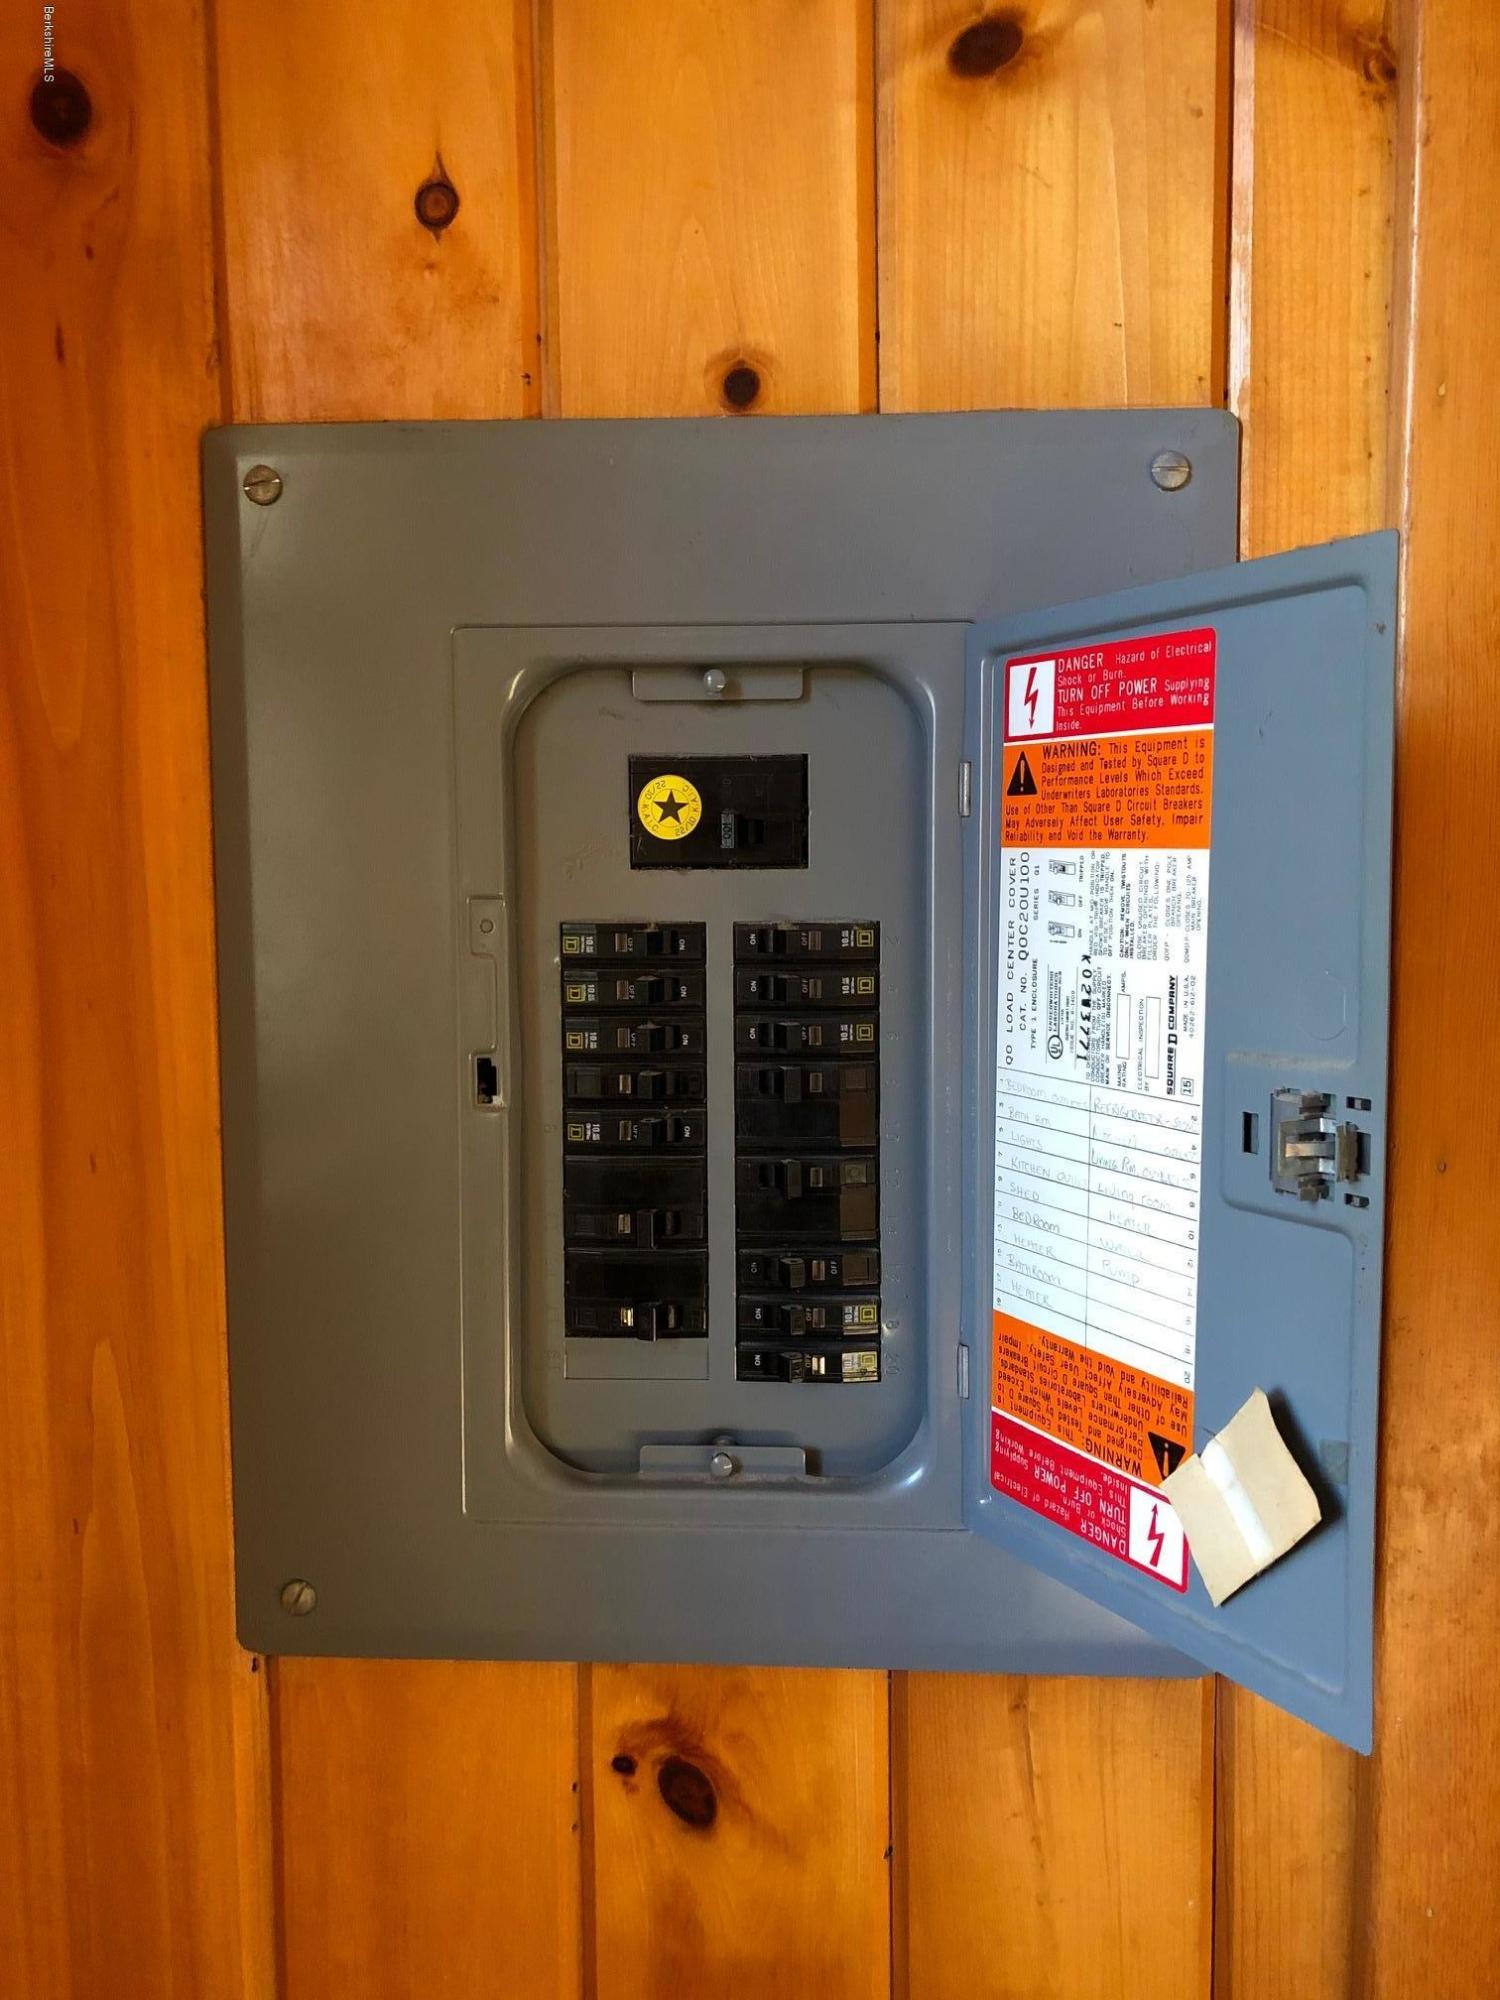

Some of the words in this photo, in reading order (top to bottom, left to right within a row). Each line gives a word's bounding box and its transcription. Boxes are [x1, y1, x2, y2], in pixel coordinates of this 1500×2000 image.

[1057, 652, 1103, 673] DANGER
[1115, 650, 1144, 664] Hazard
[1150, 648, 1159, 659] of
[1165, 639, 1211, 658] Electrical
[1057, 673, 1081, 687] Shock
[1087, 674, 1096, 682] or
[1102, 667, 1126, 680] Burn.
[1057, 687, 1083, 703] TURN
[1091, 683, 1110, 699] OFF
[1119, 677, 1157, 695] POWER
[1164, 675, 1209, 693] Supplying
[1057, 705, 1073, 717] This
[1079, 699, 1125, 716] Equipment
[1132, 696, 1163, 709] Before
[1170, 691, 1209, 708] Working
[1056, 719, 1081, 730] Inside.
[1042, 741, 1100, 759] WARNING:
[1108, 742, 1127, 753] This
[1135, 737, 1187, 754] Equipment
[1195, 736, 1204, 746] is
[1041, 761, 1075, 775] Designed
[1080, 760, 1093, 769] and
[1099, 756, 1126, 769] Tested
[1132, 755, 1141, 769] by
[1147, 753, 1176, 767] Square
[1182, 752, 1188, 763] D
[1195, 752, 1204, 762] to
[1041, 774, 1093, 787] Performance
[1100, 772, 1127, 783] Levels
[1135, 769, 1161, 781] Which
[1168, 767, 1203, 779] Exceed
[1041, 788, 1090, 800] Underwriters
[1096, 785, 1148, 797] Laboratories
[1155, 783, 1203, 794] Standards.
[1006, 805, 1018, 815] Use
[1023, 805, 1031, 814] of
[1036, 804, 1055, 813] Other
[1061, 803, 1077, 812] Than
[1083, 801, 1109, 814] Square
[1116, 800, 1121, 811] D
[1127, 799, 1156, 810] Circuit
[1163, 797, 1202, 809] Breakers
[1005, 818, 1019, 829] May
[1025, 817, 1063, 829] Adversely
[1070, 816, 1097, 826] Affect
[1103, 814, 1123, 825] User
[1172, 813, 1202, 825] Impair
[1005, 830, 1043, 842] Reliability
[1048, 830, 1061, 840] and
[1067, 830, 1083, 840] Void
[1089, 829, 1102, 839] the
[1008, 857, 1016, 907] COVER
[750, 933, 756, 945] ON
[1006, 919, 1014, 980] CENTER
[751, 980, 757, 992] ON
[1167, 974, 1176, 1030] COMPANY
[750, 1027, 756, 1039] ON
[1168, 1032, 1177, 1045] D
[1005, 1043, 1013, 1065] QO
[1166, 1046, 1174, 1095] SQUARE
[1182, 1079, 1192, 1094] 15
[998, 1331, 1020, 1350] Impair
[998, 1344, 1027, 1366] Breakers
[1079, 1353, 1091, 1367] the
[1033, 1360, 1057, 1379] Circuit
[1060, 1359, 1078, 1375] User
[1097, 1361, 1114, 1376] Void
[997, 1382, 1004, 1393] to
[998, 1370, 1024, 1390] Exceed
[1062, 1373, 1067, 1384] D
[1072, 1375, 1097, 1398] Square
[1084, 1369, 1111, 1389] Affect
[1120, 1370, 1134, 1385] and
[1008, 1387, 1013, 1397] D
[1029, 1384, 1051, 1402] Which
[1039, 1375, 1085, 1405] Laboratories
[1104, 1391, 1120, 1407] Than
[1118, 1382, 1162, 1411] Adversely
[1141, 1377, 1187, 1408] Reliability
[997, 1395, 1004, 1406] is
[1017, 1390, 1040, 1411] Square
[1045, 1403, 1053, 1417] by
[1056, 1396, 1082, 1417] Levels
[1127, 1401, 1150, 1420] Other
[1010, 1399, 1051, 1429] Equipment
[1058, 1411, 1082, 1431] Tested
[1091, 1398, 1143, 1431] Underwriters
[1156, 1413, 1164, 1426] of
[1169, 1403, 1187, 1422] May
[1057, 1424, 1073, 1441] This
[1088, 1411, 1142, 1445] Performance
[1088, 1425, 1101, 1439] and
[1170, 1420, 1186, 1436] Use
[995, 1428, 1023, 1453] Working
[1106, 1431, 1142, 1459] Designed
[995, 1441, 1028, 1470] Supplying
[1028, 1448, 1054, 1470] Before
[1081, 1435, 1141, 1477] WARNING:
[994, 1469, 1027, 1498] Electrical
[1034, 1463, 1066, 1493] POWER
[1059, 1462, 1102, 1495] Equipment
[1100, 1471, 1127, 1493] Inside.
[1032, 1491, 1039, 1504] of
[1059, 1493, 1080, 1513] Burn.
[1074, 1484, 1091, 1506] OFF
[1108, 1489, 1125, 1507] This
[1044, 1497, 1069, 1520] Hazard
[1087, 1508, 1095, 1519] or
[1099, 1497, 1126, 1523] TURN
[1080, 1517, 1125, 1554] DANGER
[1101, 1515, 1126, 1538] Shock
